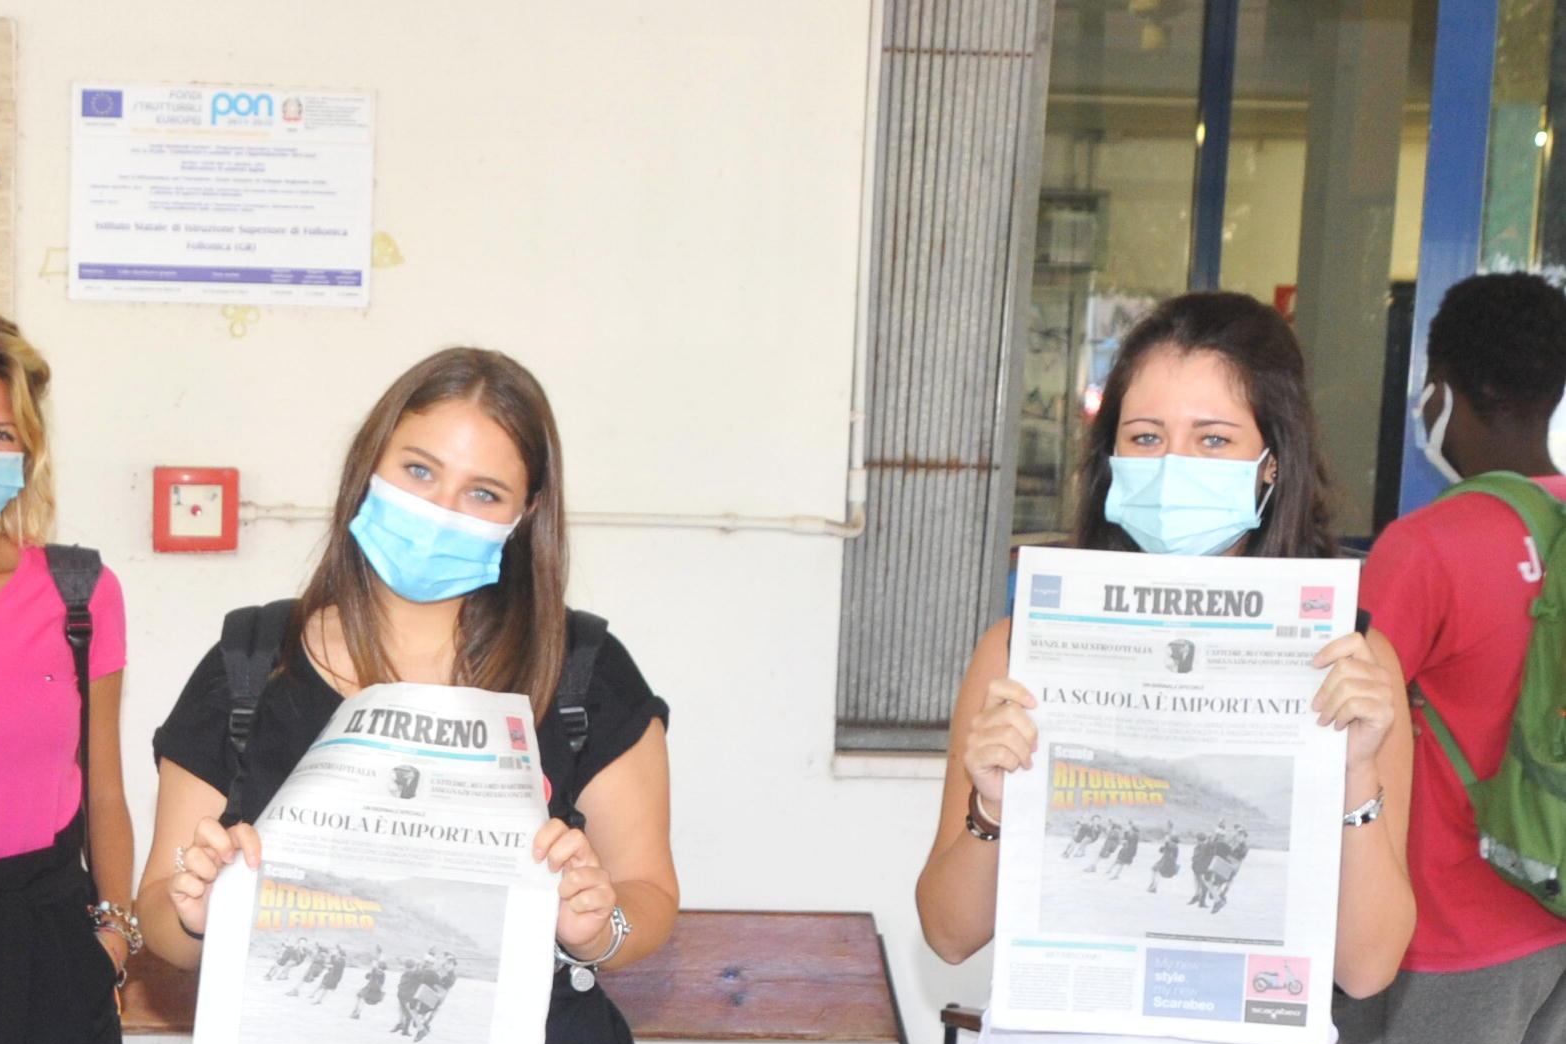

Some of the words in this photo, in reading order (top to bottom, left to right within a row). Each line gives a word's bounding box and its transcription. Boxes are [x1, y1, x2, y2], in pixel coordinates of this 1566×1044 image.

[210, 91, 274, 126] pon
[1103, 584, 1130, 613] IL
[1133, 585, 1264, 619] TIRRENO
[1071, 688, 1150, 710] SCUOLA
[1172, 696, 1307, 715] IMPORTANTE
[344, 708, 366, 734] IL
[368, 708, 488, 749] TIRRENO
[1081, 790, 1165, 809] FUTURO
[290, 806, 369, 832] SCUOLA
[391, 820, 527, 850] IMPORTANTE
[288, 911, 376, 929] FUTURO
[1152, 996, 1216, 1011] Scarabeo
